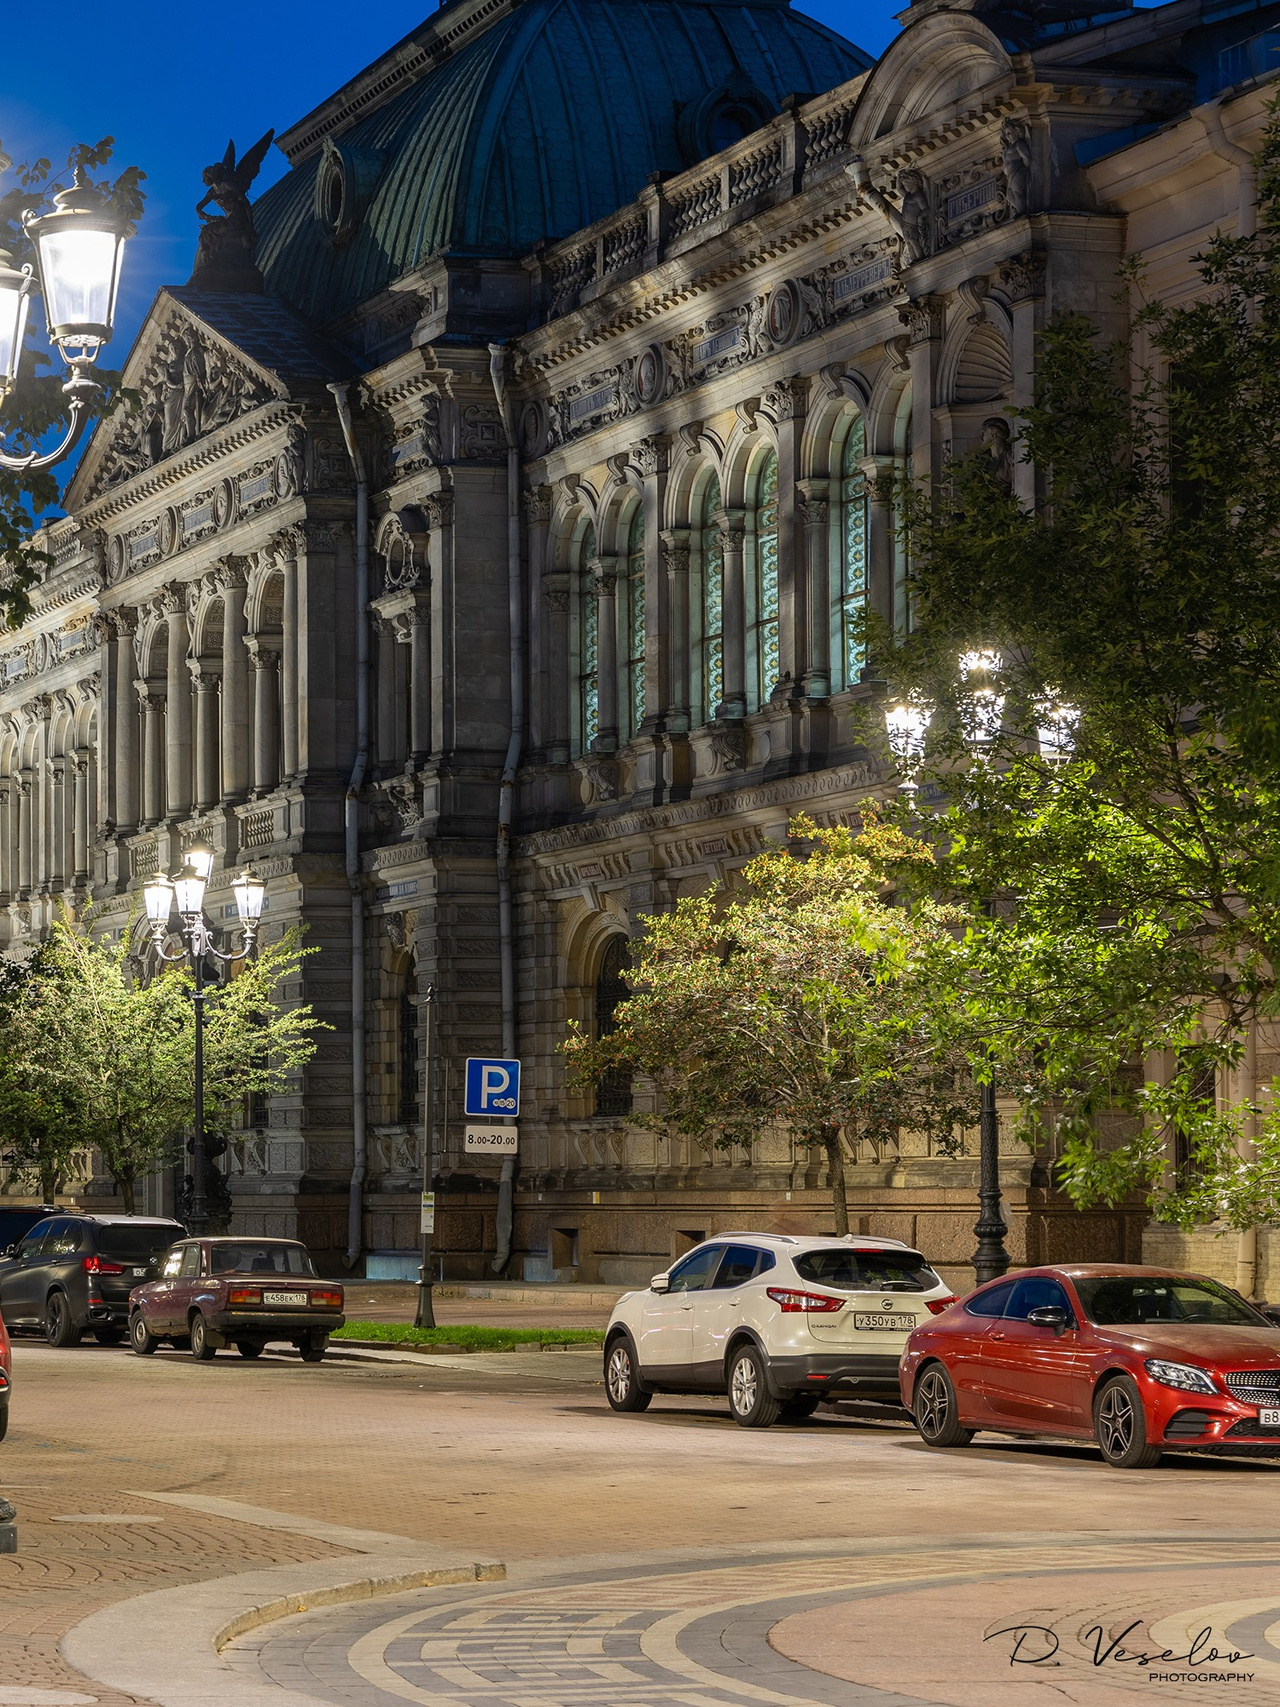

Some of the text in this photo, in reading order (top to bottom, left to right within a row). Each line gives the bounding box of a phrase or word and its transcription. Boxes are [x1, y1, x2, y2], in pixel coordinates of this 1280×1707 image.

[481, 1065, 510, 1109] P
[468, 1134, 516, 1145] 8.00-20.00
[898, 1316, 913, 1325] 178
